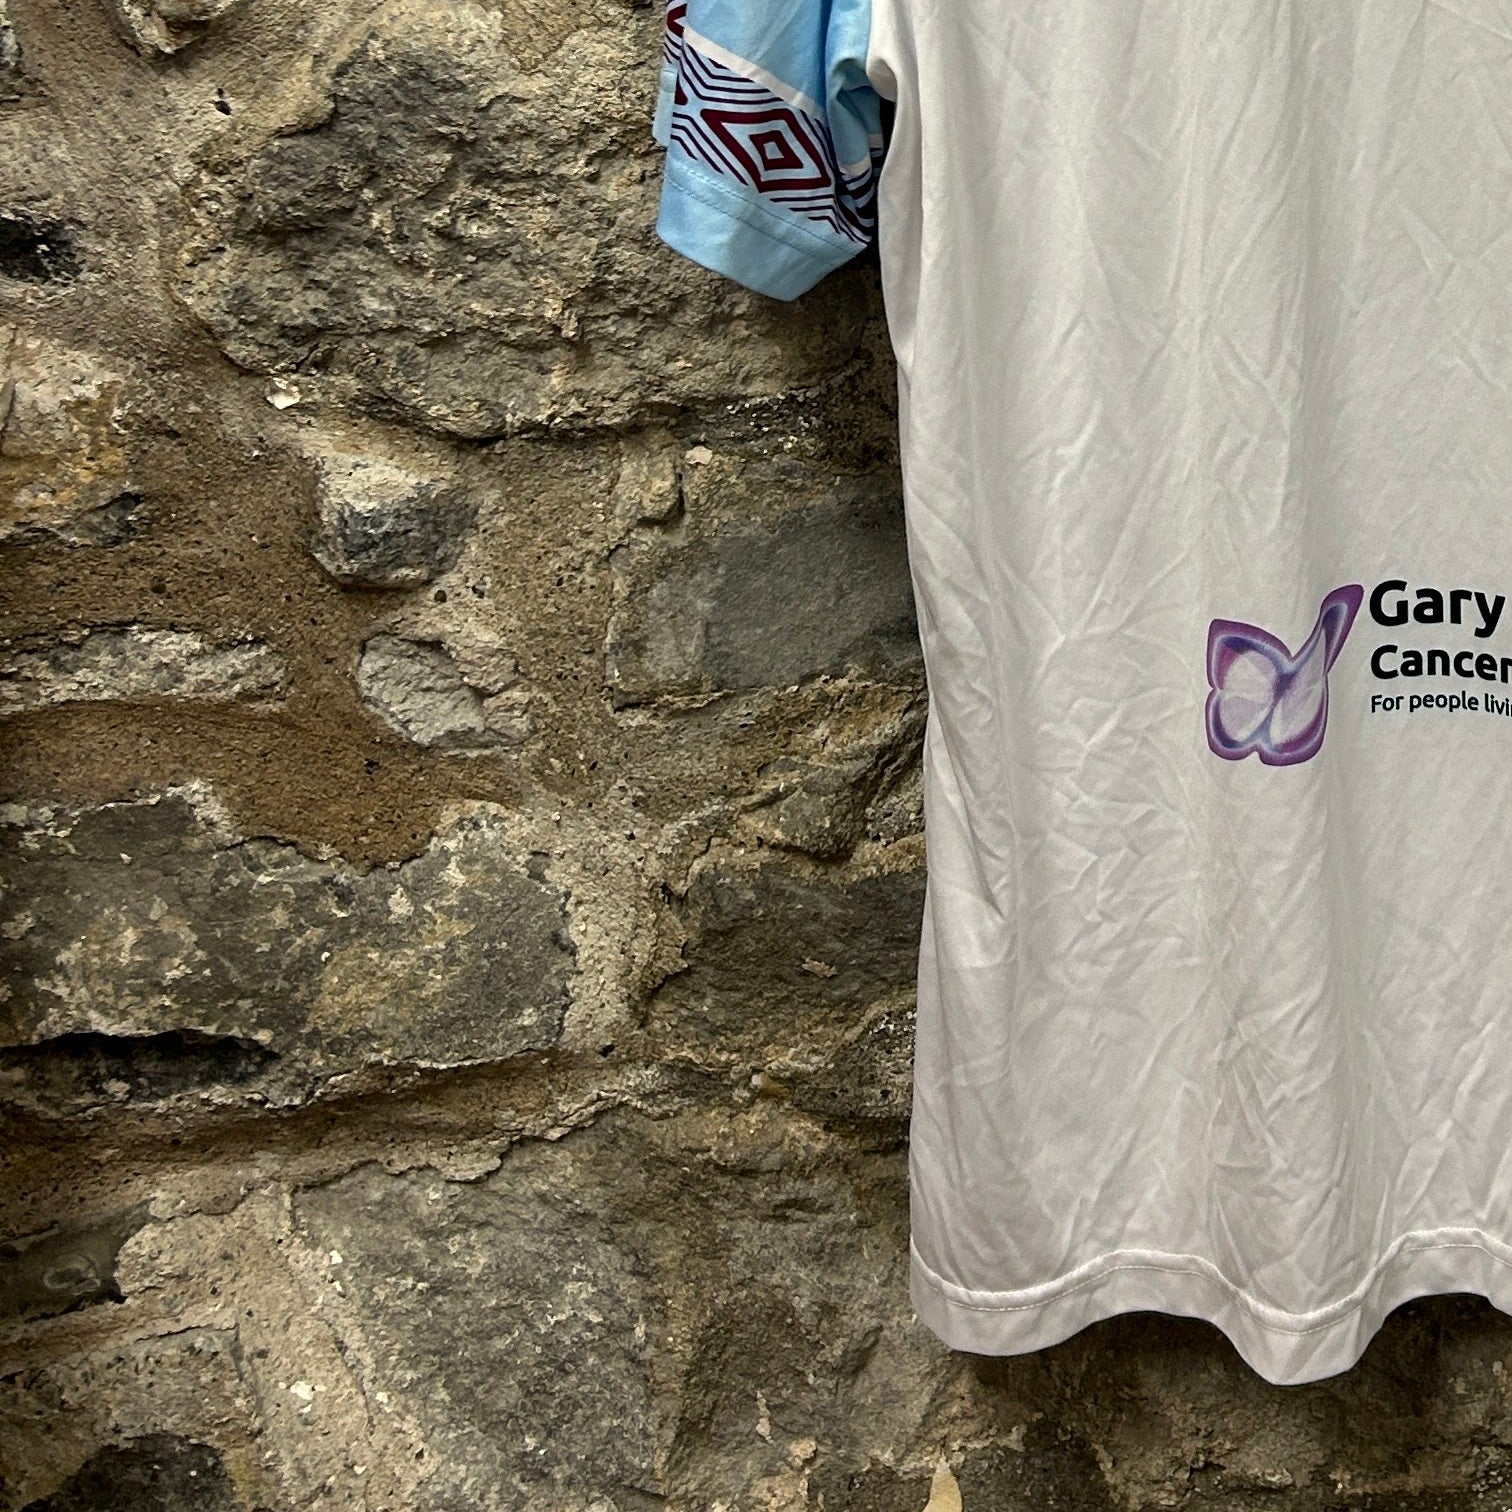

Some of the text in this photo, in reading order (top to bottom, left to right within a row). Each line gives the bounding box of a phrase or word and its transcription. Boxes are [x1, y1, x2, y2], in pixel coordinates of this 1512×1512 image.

[1368, 578, 1506, 639] Gary
[1371, 694, 1405, 714] For
[1409, 690, 1480, 713] people
